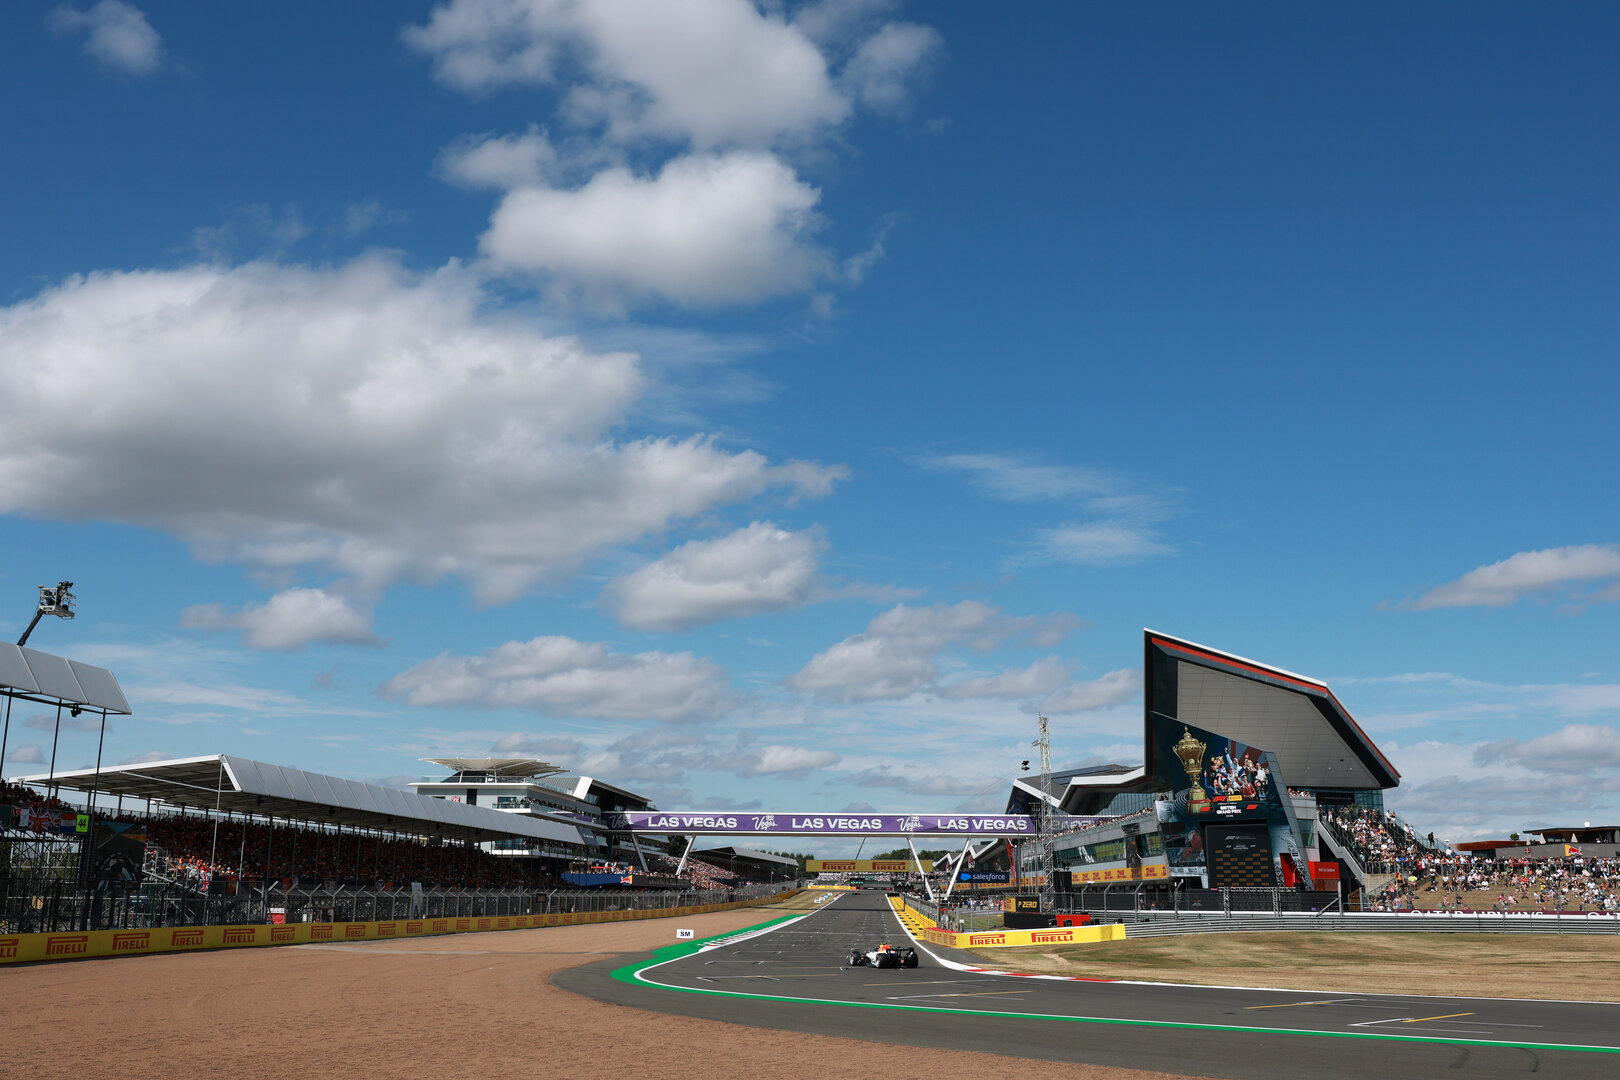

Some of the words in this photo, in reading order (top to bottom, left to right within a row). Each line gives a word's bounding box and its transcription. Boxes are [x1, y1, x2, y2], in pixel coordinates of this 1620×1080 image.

[648, 816, 680, 828] LAS
[683, 817, 738, 828] VEGAS
[792, 818, 824, 828] LAS
[827, 818, 882, 829] VEGAS
[938, 818, 969, 830] LAS
[971, 819, 1027, 830] VEGAS
[822, 862, 856, 870] PIRELLI
[872, 862, 906, 870] PIRELLI
[972, 873, 1006, 881] salesforce
[172, 930, 204, 946] PIRELLI
[223, 928, 255, 944] PIRELLI
[271, 927, 295, 941] PIRELLI
[970, 934, 1005, 945] PIRELLI
[1031, 931, 1073, 942] PIRELLI
[46, 936, 88, 955] PIRELLI
[112, 932, 150, 950] PIRELLI
